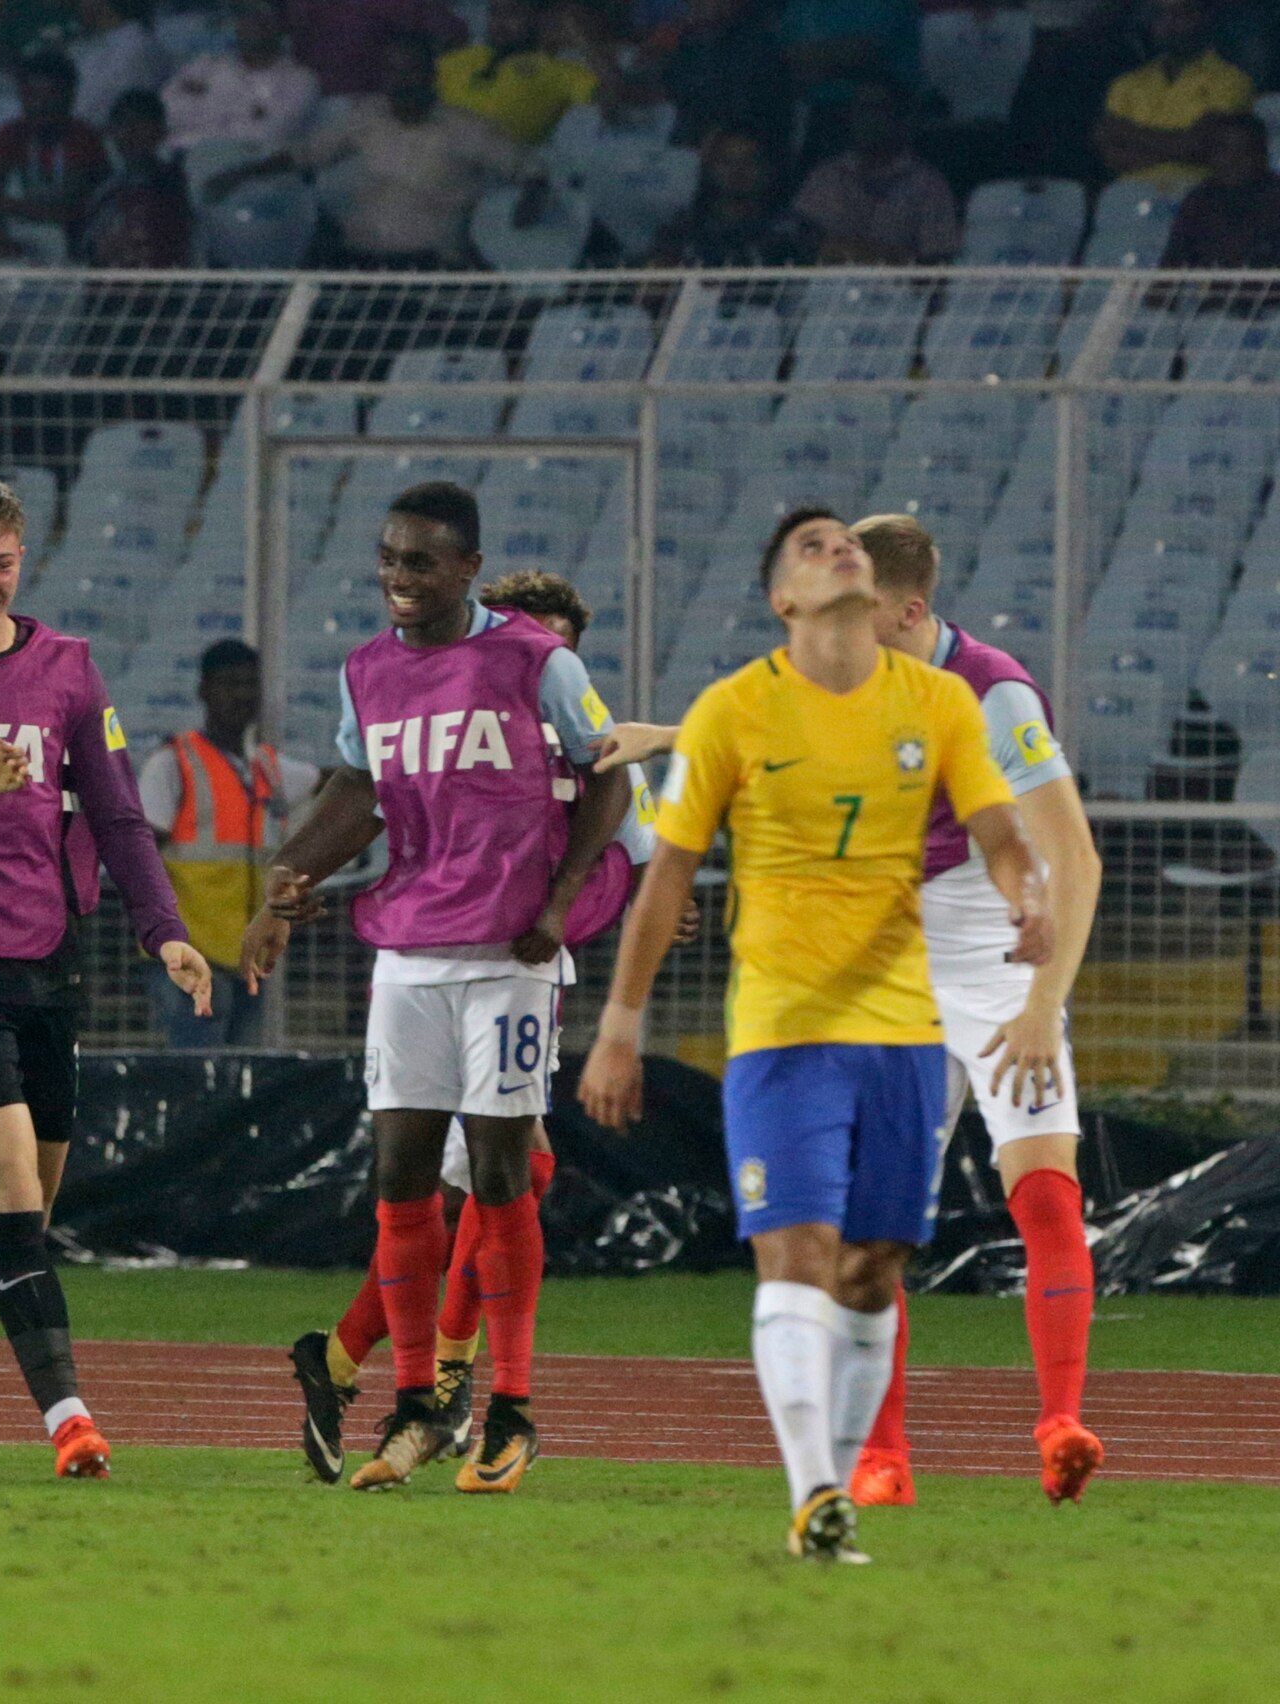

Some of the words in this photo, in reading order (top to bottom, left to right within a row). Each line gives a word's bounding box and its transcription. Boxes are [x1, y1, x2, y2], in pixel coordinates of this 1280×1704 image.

[366, 709, 513, 783] FIFA
[832, 794, 863, 859] 7
[494, 1013, 541, 1073] 18
